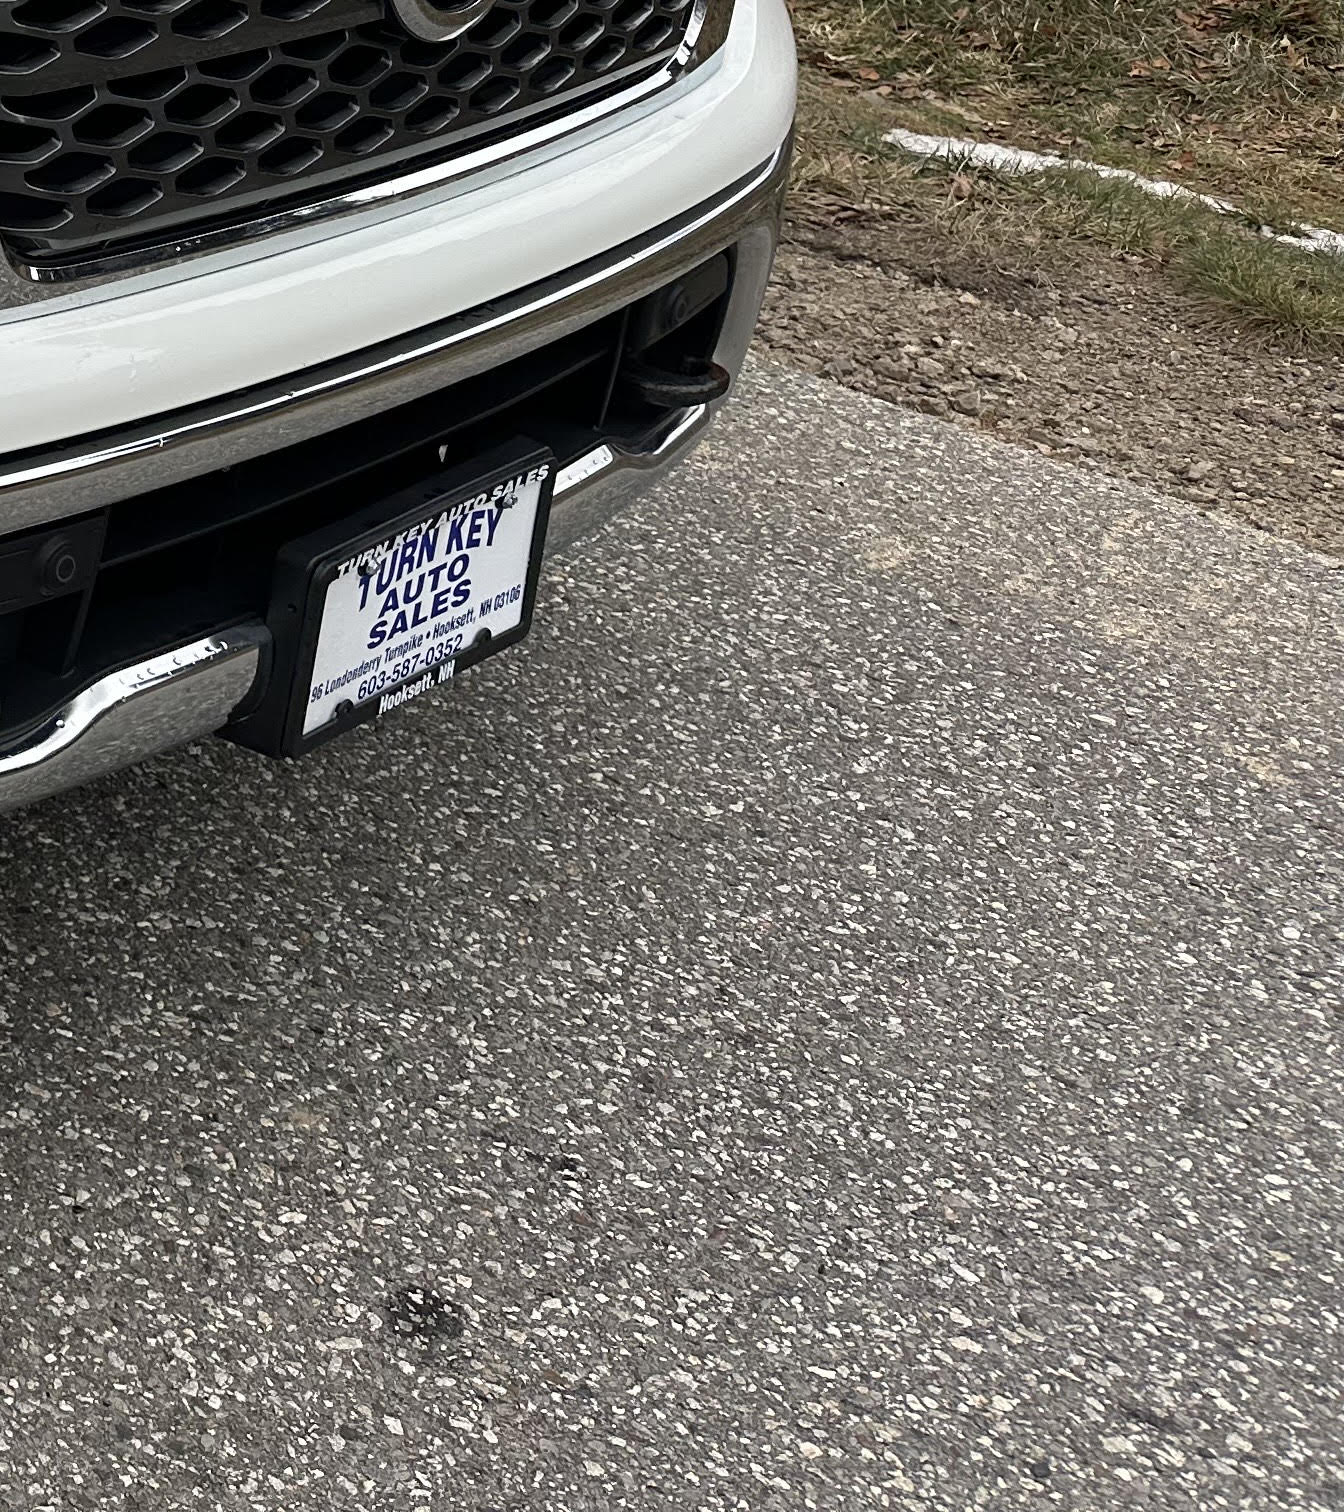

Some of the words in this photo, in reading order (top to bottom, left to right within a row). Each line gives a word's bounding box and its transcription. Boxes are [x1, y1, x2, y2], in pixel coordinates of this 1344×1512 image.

[337, 540, 390, 578] TURN
[392, 518, 433, 549] KEY
[435, 494, 488, 528] AUTO
[491, 465, 549, 501] SALES
[358, 527, 440, 612] TURN
[446, 508, 504, 555] KEY
[378, 554, 470, 619] AUTO
[367, 579, 471, 649] SALES
[384, 634, 423, 664] Turnpike
[432, 607, 476, 640] Hooksett,
[479, 598, 492, 618] NH
[494, 584, 521, 611] 03106
[357, 633, 463, 700] 603-587-0352
[438, 660, 455, 684] NH
